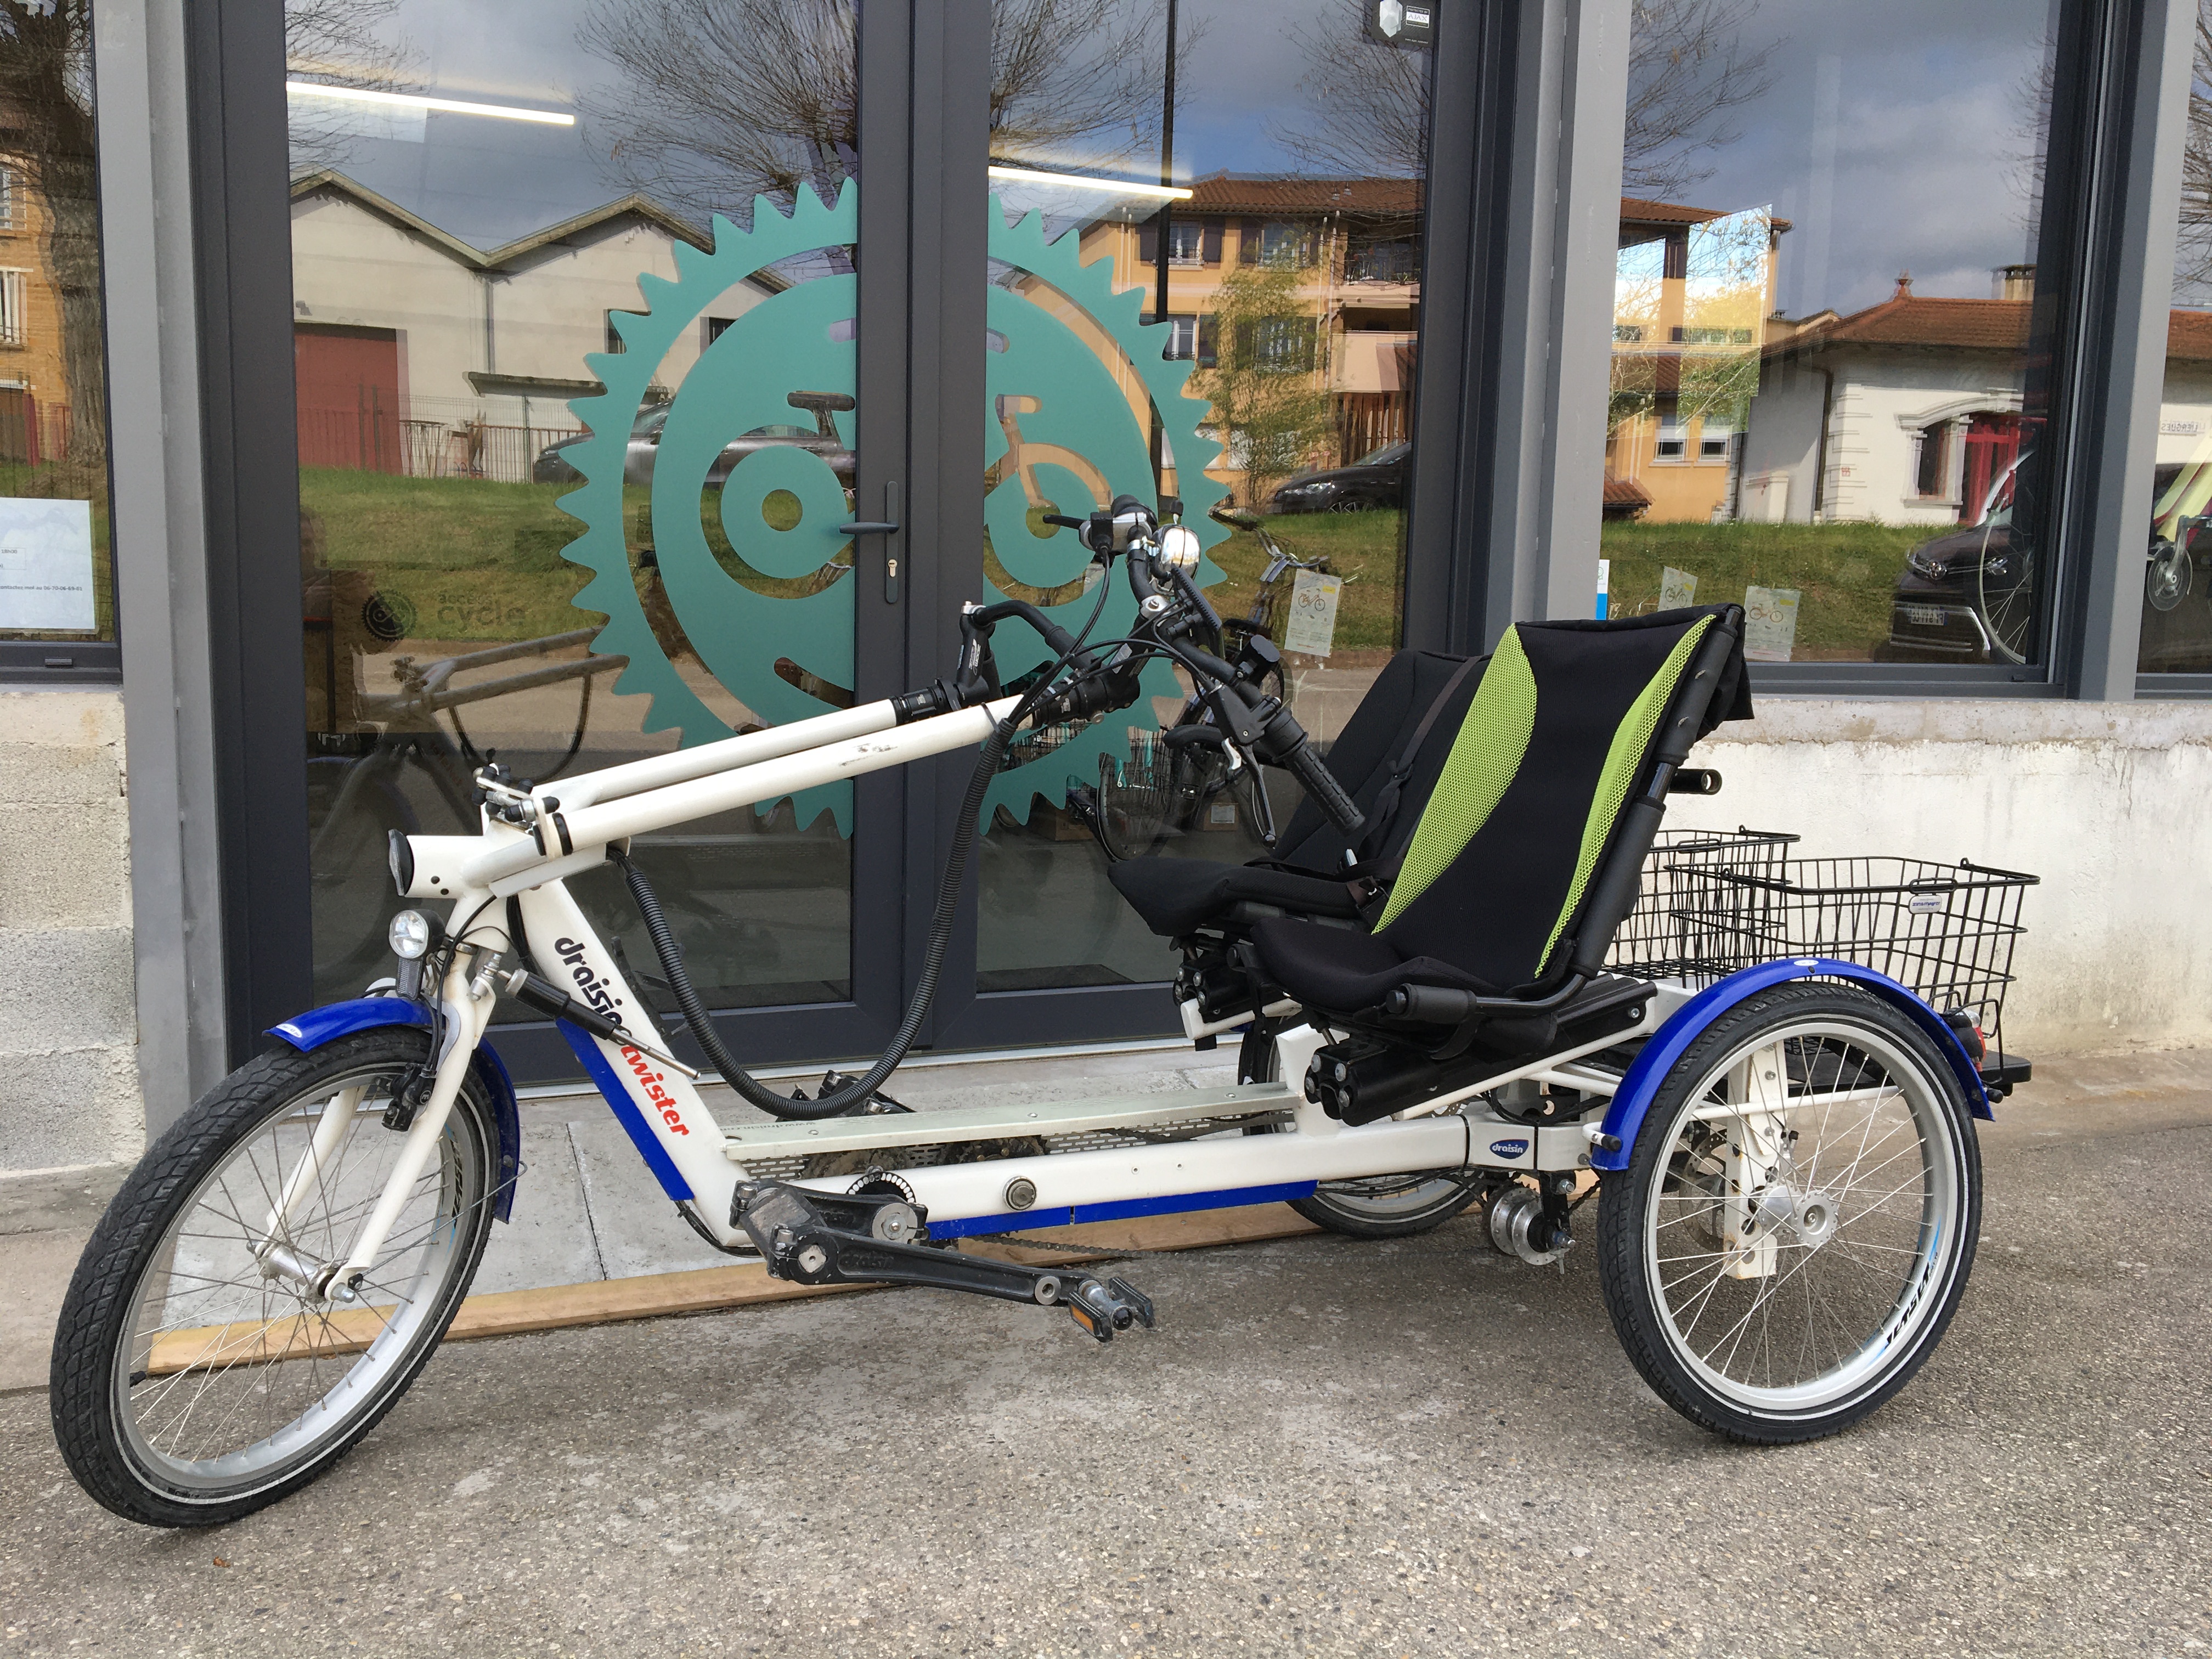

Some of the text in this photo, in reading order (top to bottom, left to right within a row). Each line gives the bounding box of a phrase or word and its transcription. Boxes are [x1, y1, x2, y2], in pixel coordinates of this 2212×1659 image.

[437, 599, 526, 633] cycle
[620, 1043, 690, 1136] twister
[1492, 1143, 1523, 1153] draisin
